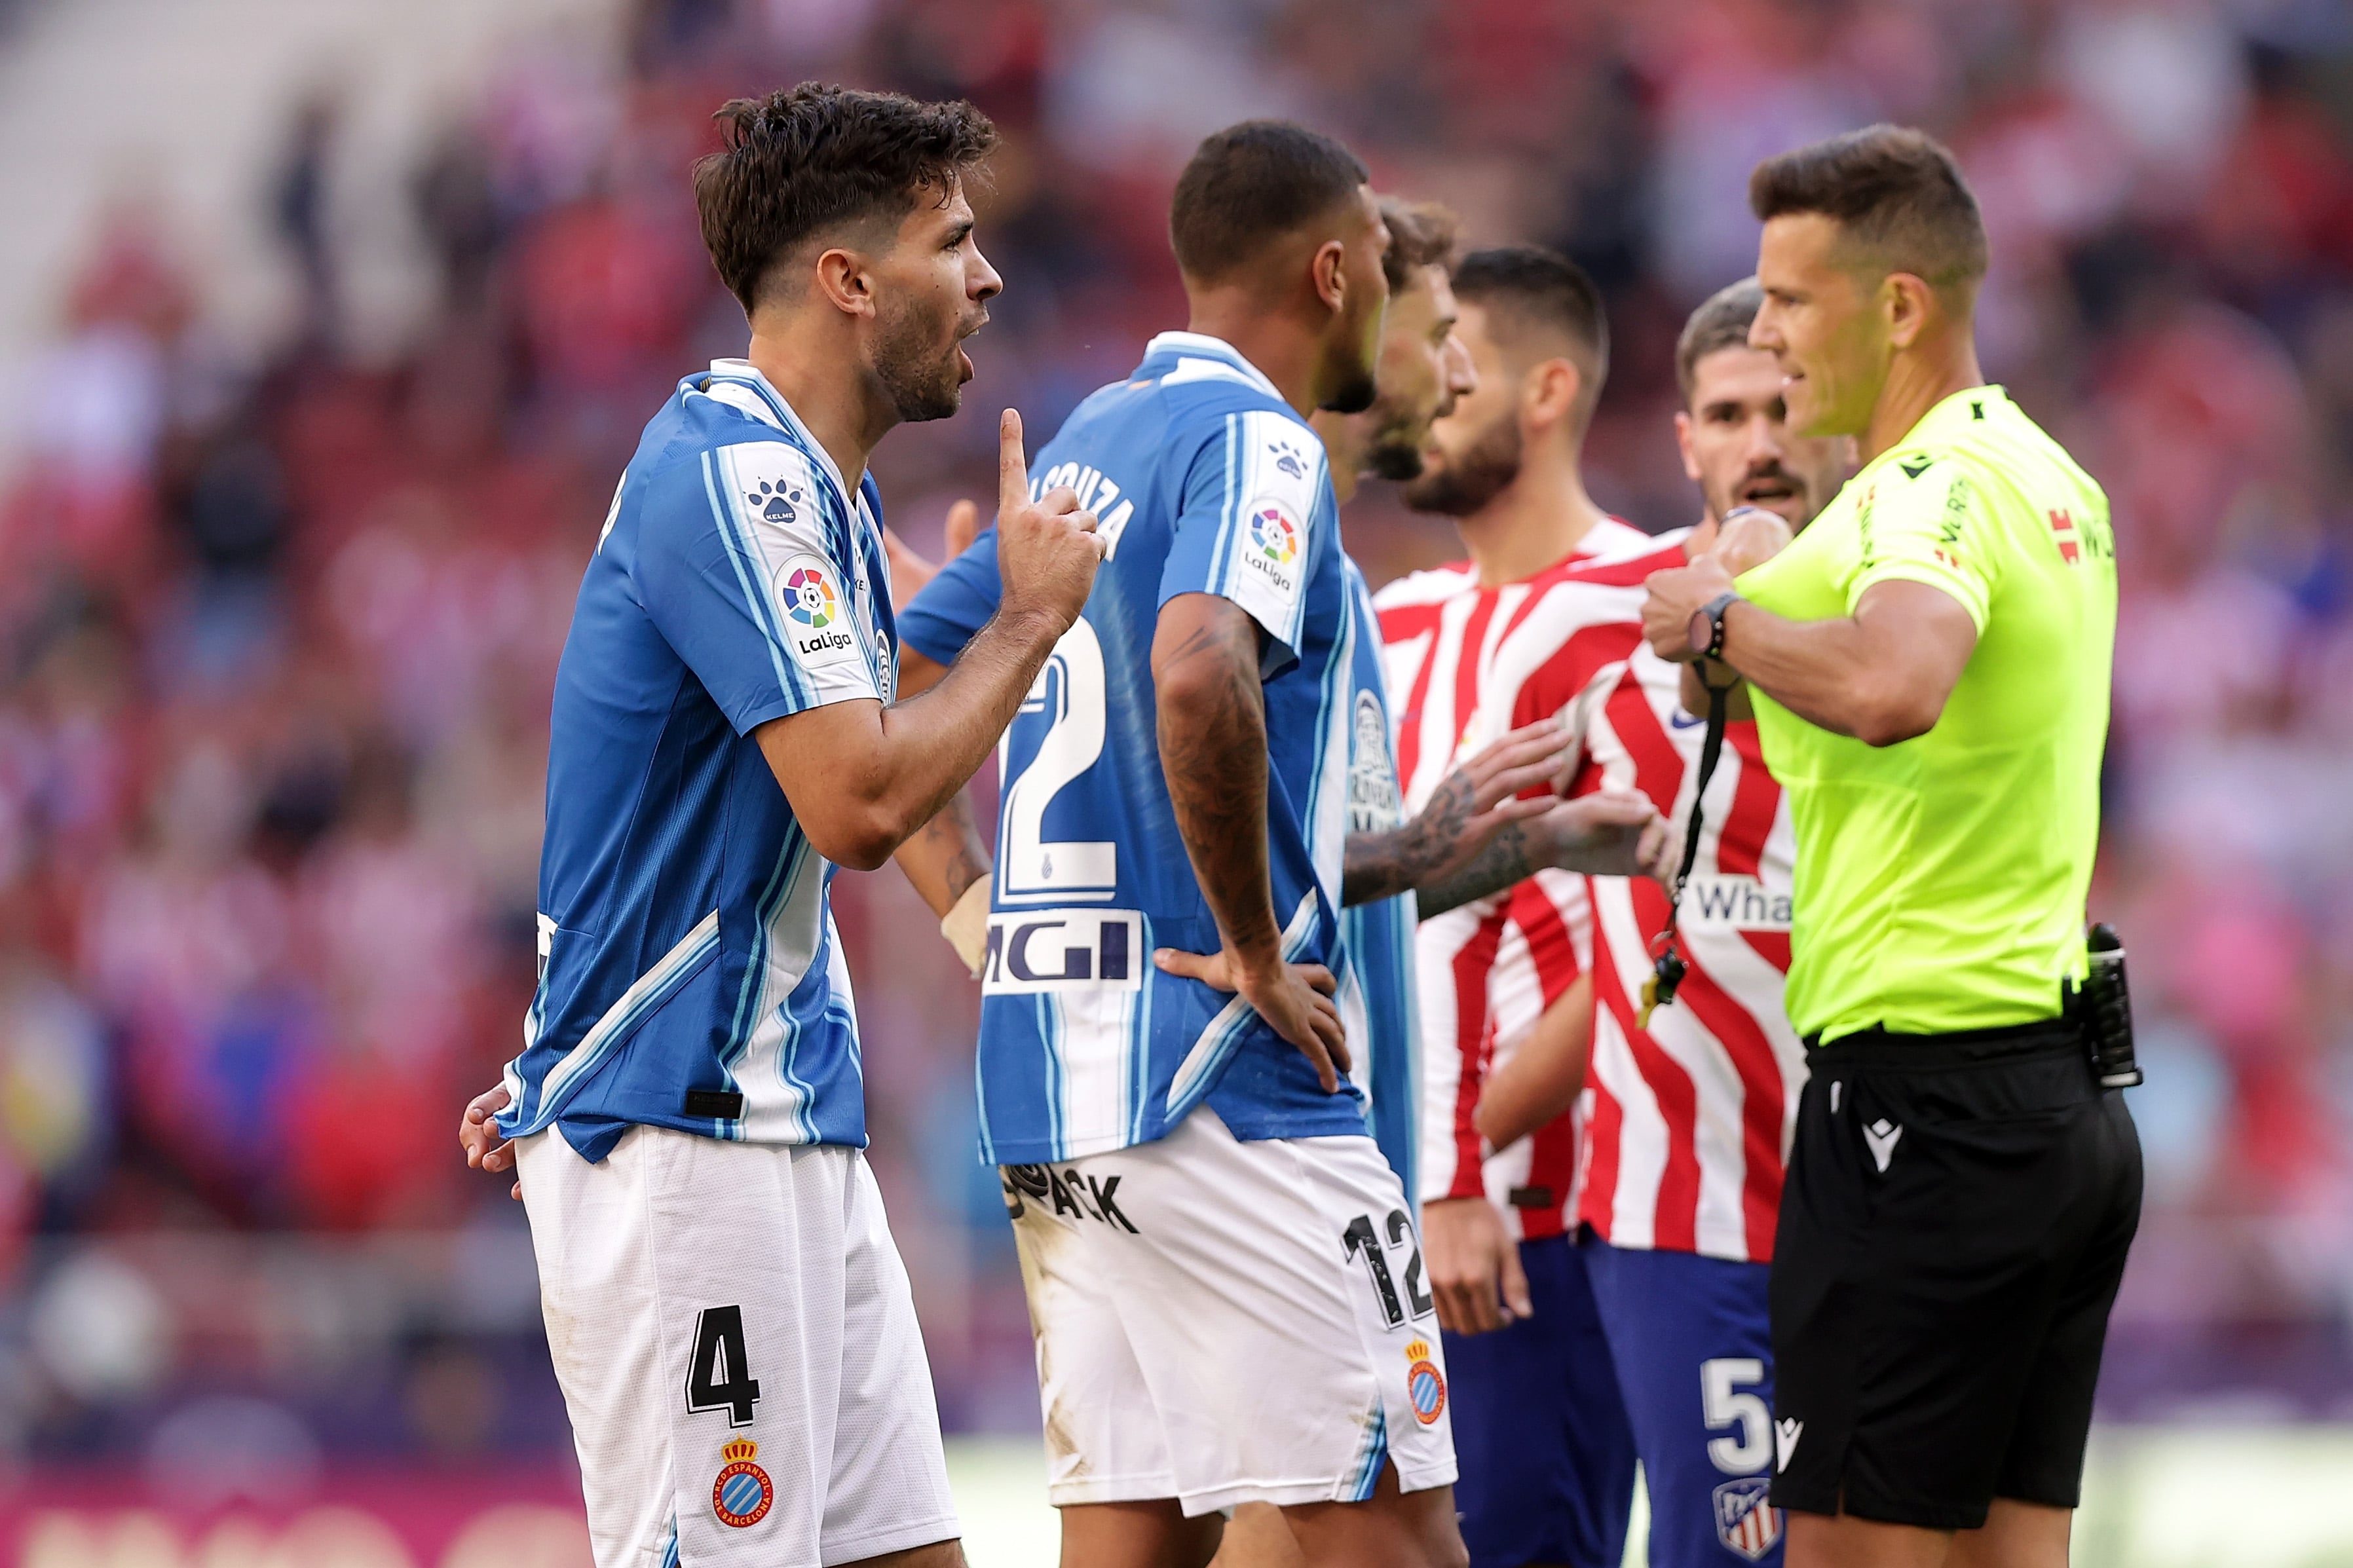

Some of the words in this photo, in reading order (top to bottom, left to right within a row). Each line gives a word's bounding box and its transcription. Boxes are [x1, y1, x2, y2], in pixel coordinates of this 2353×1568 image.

[1245, 551, 1291, 591] LaLiga
[799, 632, 852, 654] LaLiga
[998, 614, 1116, 905] 2
[1340, 1209, 1435, 1330] 12
[685, 1304, 761, 1429] 4
[1700, 1358, 1773, 1476] 5
[714, 1472, 727, 1492] RCD
[728, 1463, 771, 1491] ESPANYOL
[715, 1499, 723, 1512] DE
[721, 1497, 771, 1525] BARCELONA
